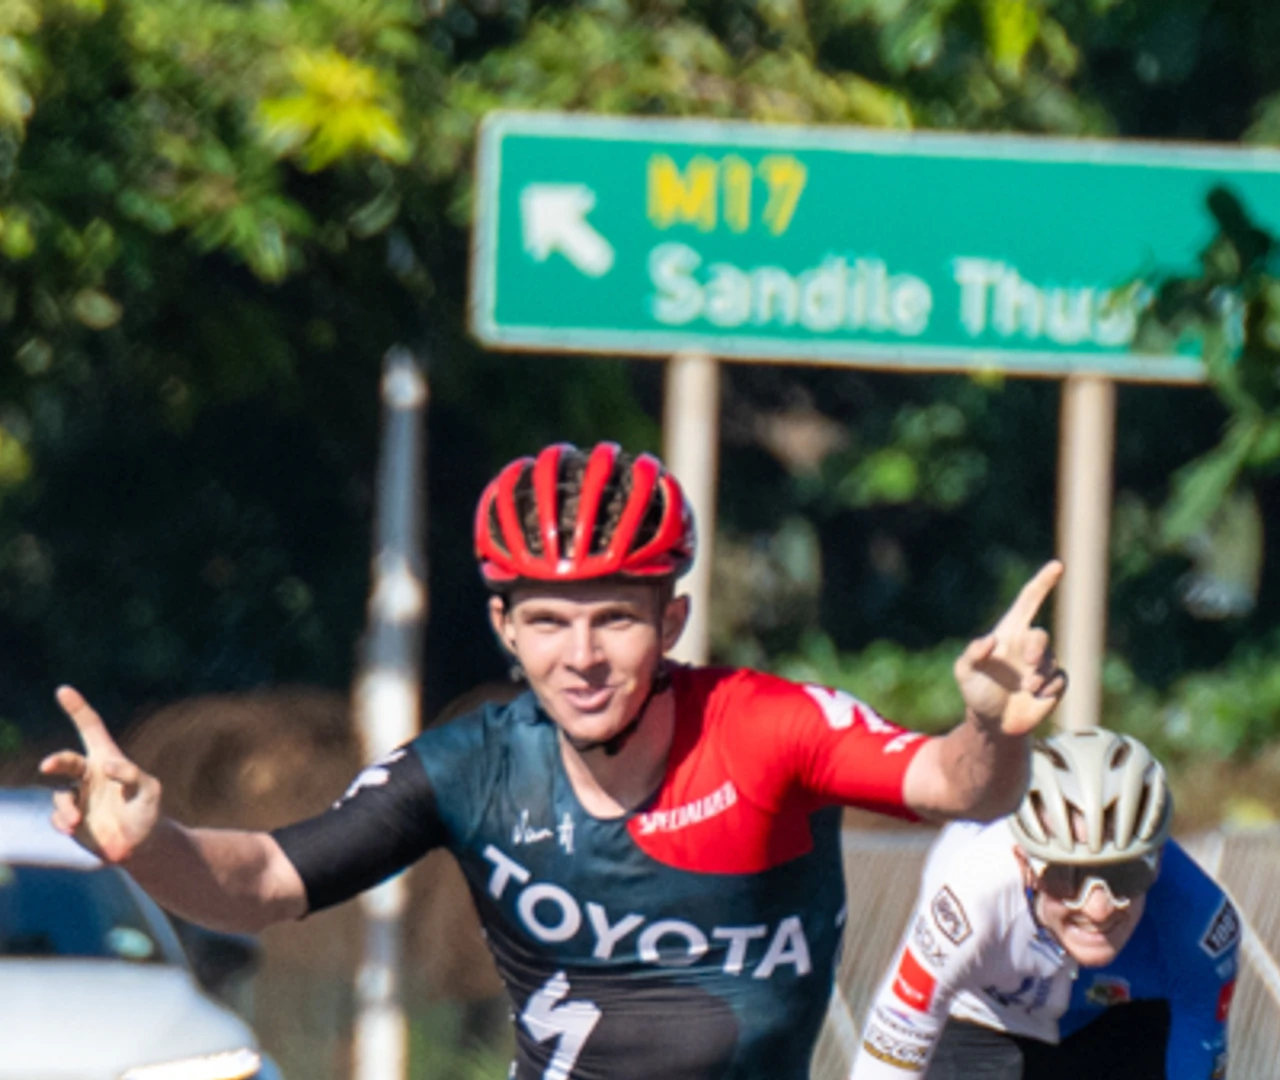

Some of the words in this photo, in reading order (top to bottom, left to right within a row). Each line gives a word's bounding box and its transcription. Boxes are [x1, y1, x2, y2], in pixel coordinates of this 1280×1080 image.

[647, 154, 807, 235] M17
[648, 242, 932, 336] Sandile
[484, 844, 811, 978] TOYOTA
